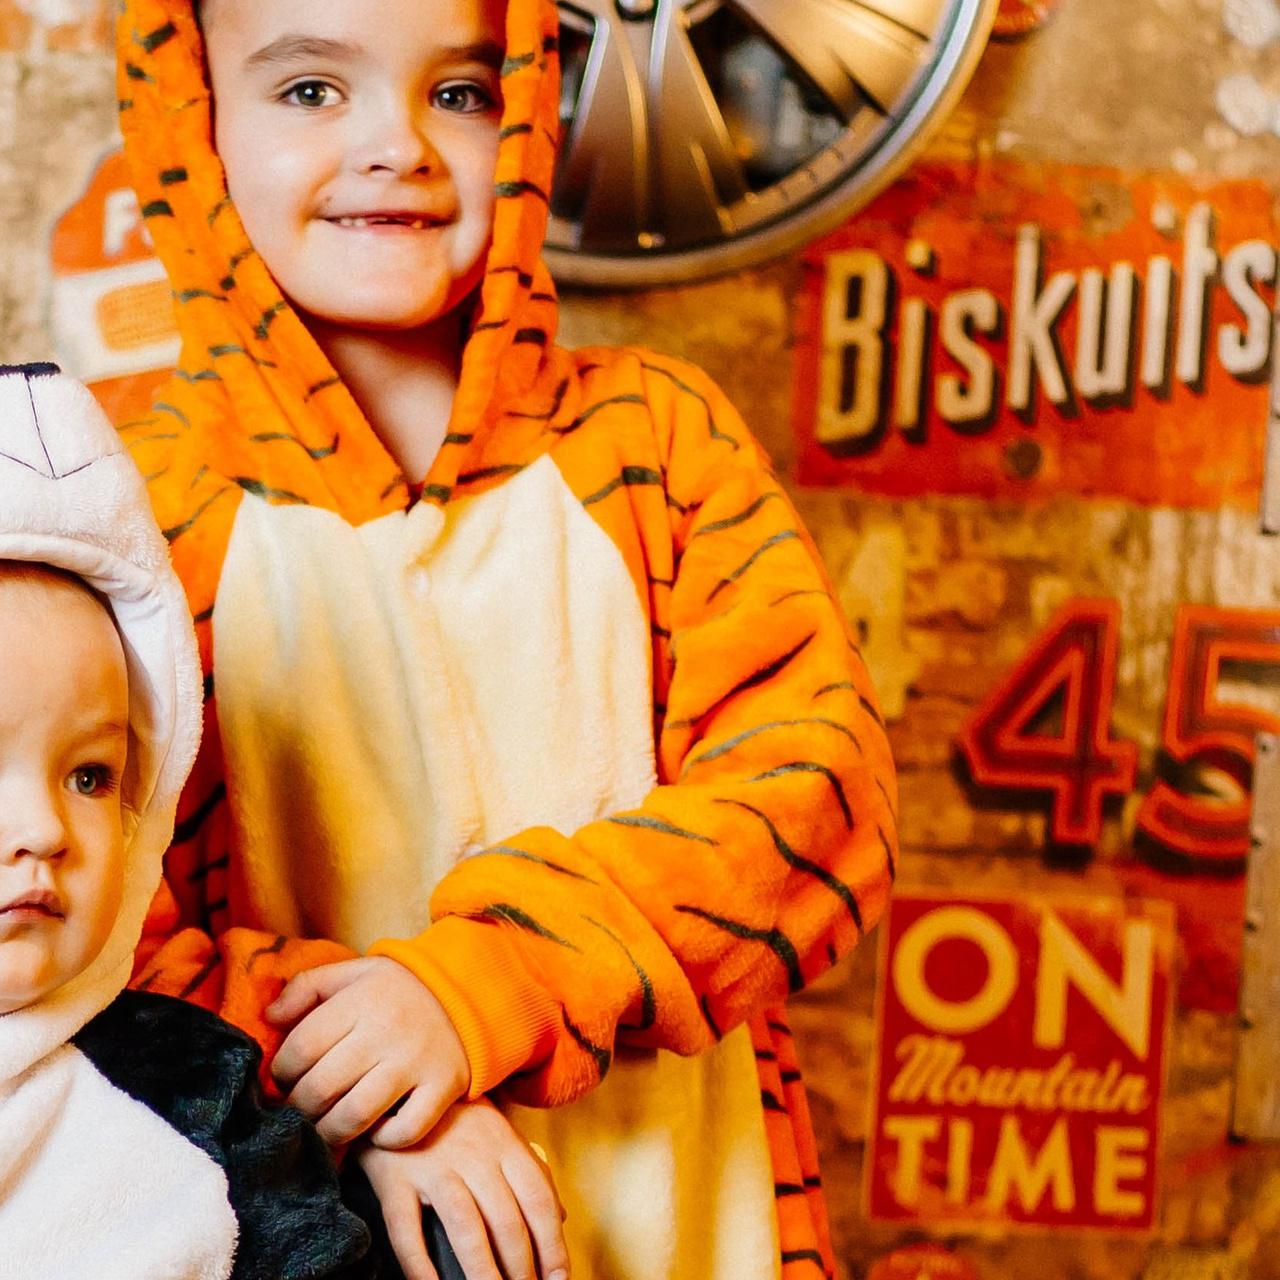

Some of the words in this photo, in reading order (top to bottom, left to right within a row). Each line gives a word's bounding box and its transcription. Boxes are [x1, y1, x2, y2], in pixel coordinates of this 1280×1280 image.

[814, 201, 1280, 448] Biskuits
[892, 904, 1157, 1062] ON
[887, 1034, 1150, 1115] Mountain
[881, 1115, 1149, 1216] TIME
